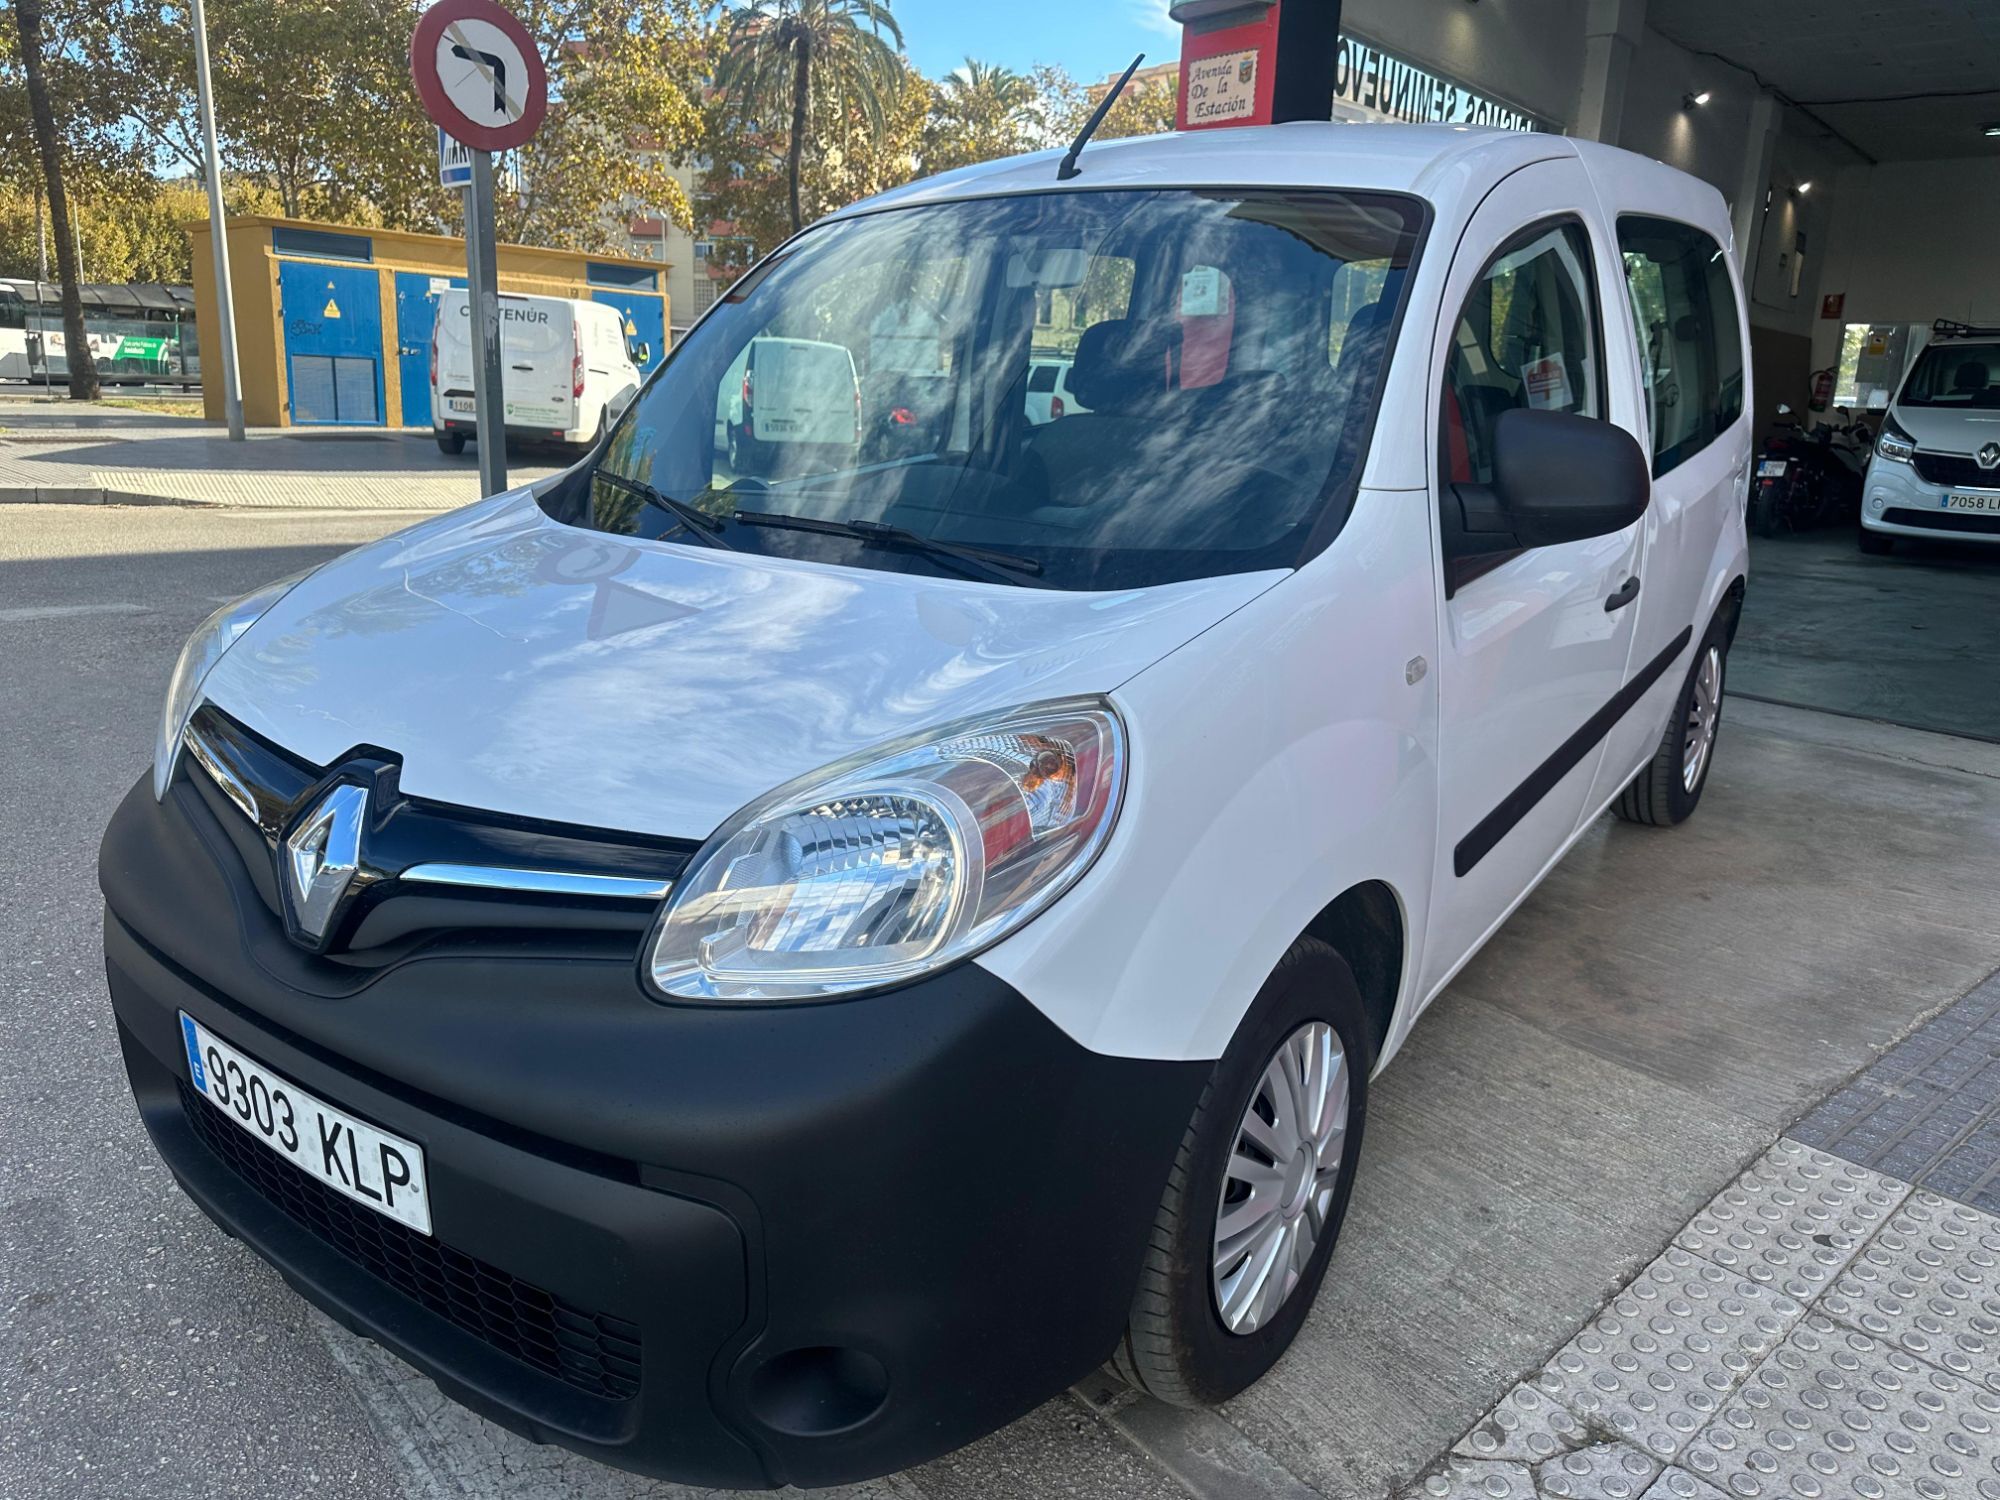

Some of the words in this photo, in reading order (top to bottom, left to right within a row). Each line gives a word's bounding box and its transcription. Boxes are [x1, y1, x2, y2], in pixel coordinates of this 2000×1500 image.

[1191, 59, 1233, 83] Avenida
[1191, 83, 1209, 100] De
[1216, 76, 1228, 94] la
[1194, 94, 1246, 118] Estación
[459, 305, 549, 324] CENUR
[1950, 496, 1985, 509] 7058
[1988, 498, 2000, 510] L
[207, 1045, 299, 1153] 9303
[317, 1112, 411, 1208] KLP
